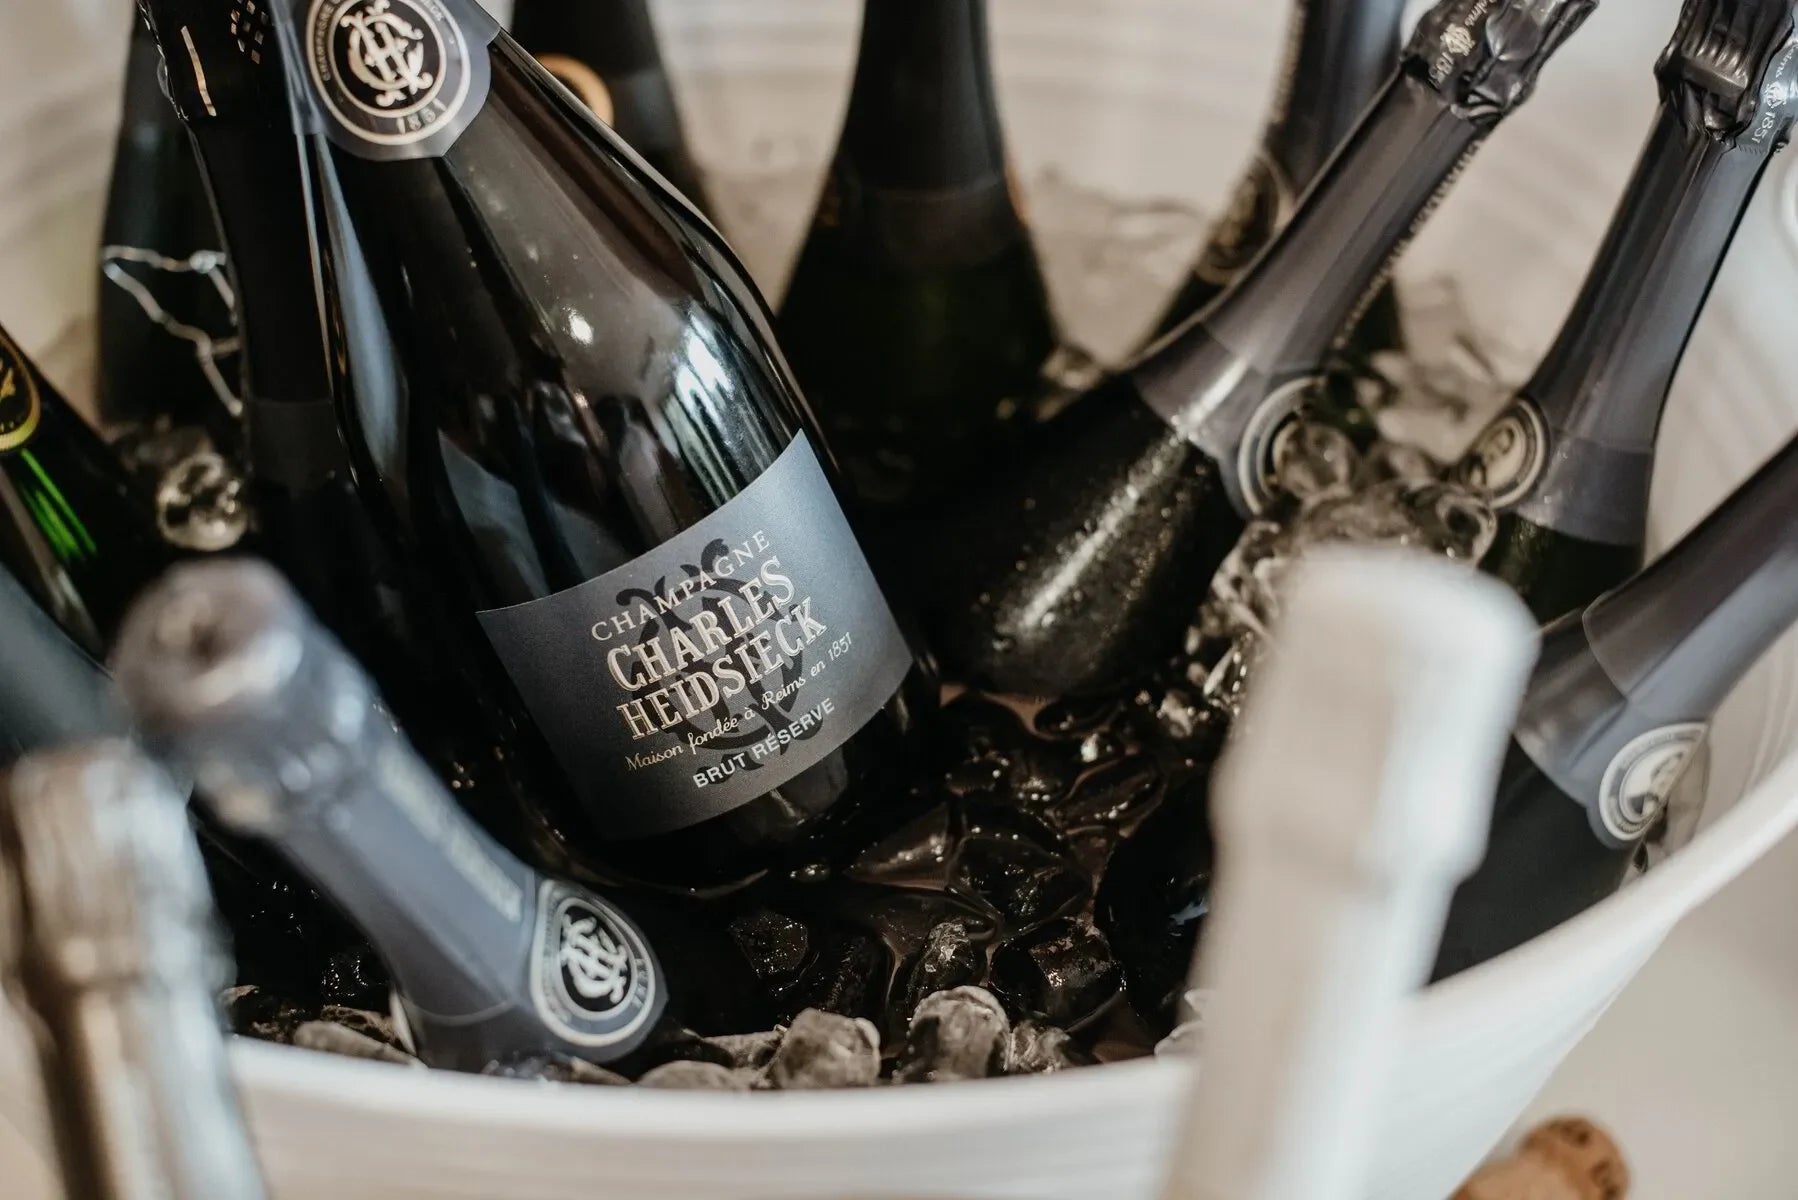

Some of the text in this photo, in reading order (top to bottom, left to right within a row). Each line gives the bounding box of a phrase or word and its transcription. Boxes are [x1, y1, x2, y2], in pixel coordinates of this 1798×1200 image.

[396, 97, 447, 134] 1851
[1751, 111, 1775, 143] 1851
[591, 530, 770, 641] CHAMPAGNE
[607, 555, 795, 692] CHARLES
[616, 596, 828, 740] HEIDSIECK
[625, 631, 853, 772] Maison fondée à Reims en 1851
[692, 697, 836, 789] BRUT RÉSERVE
